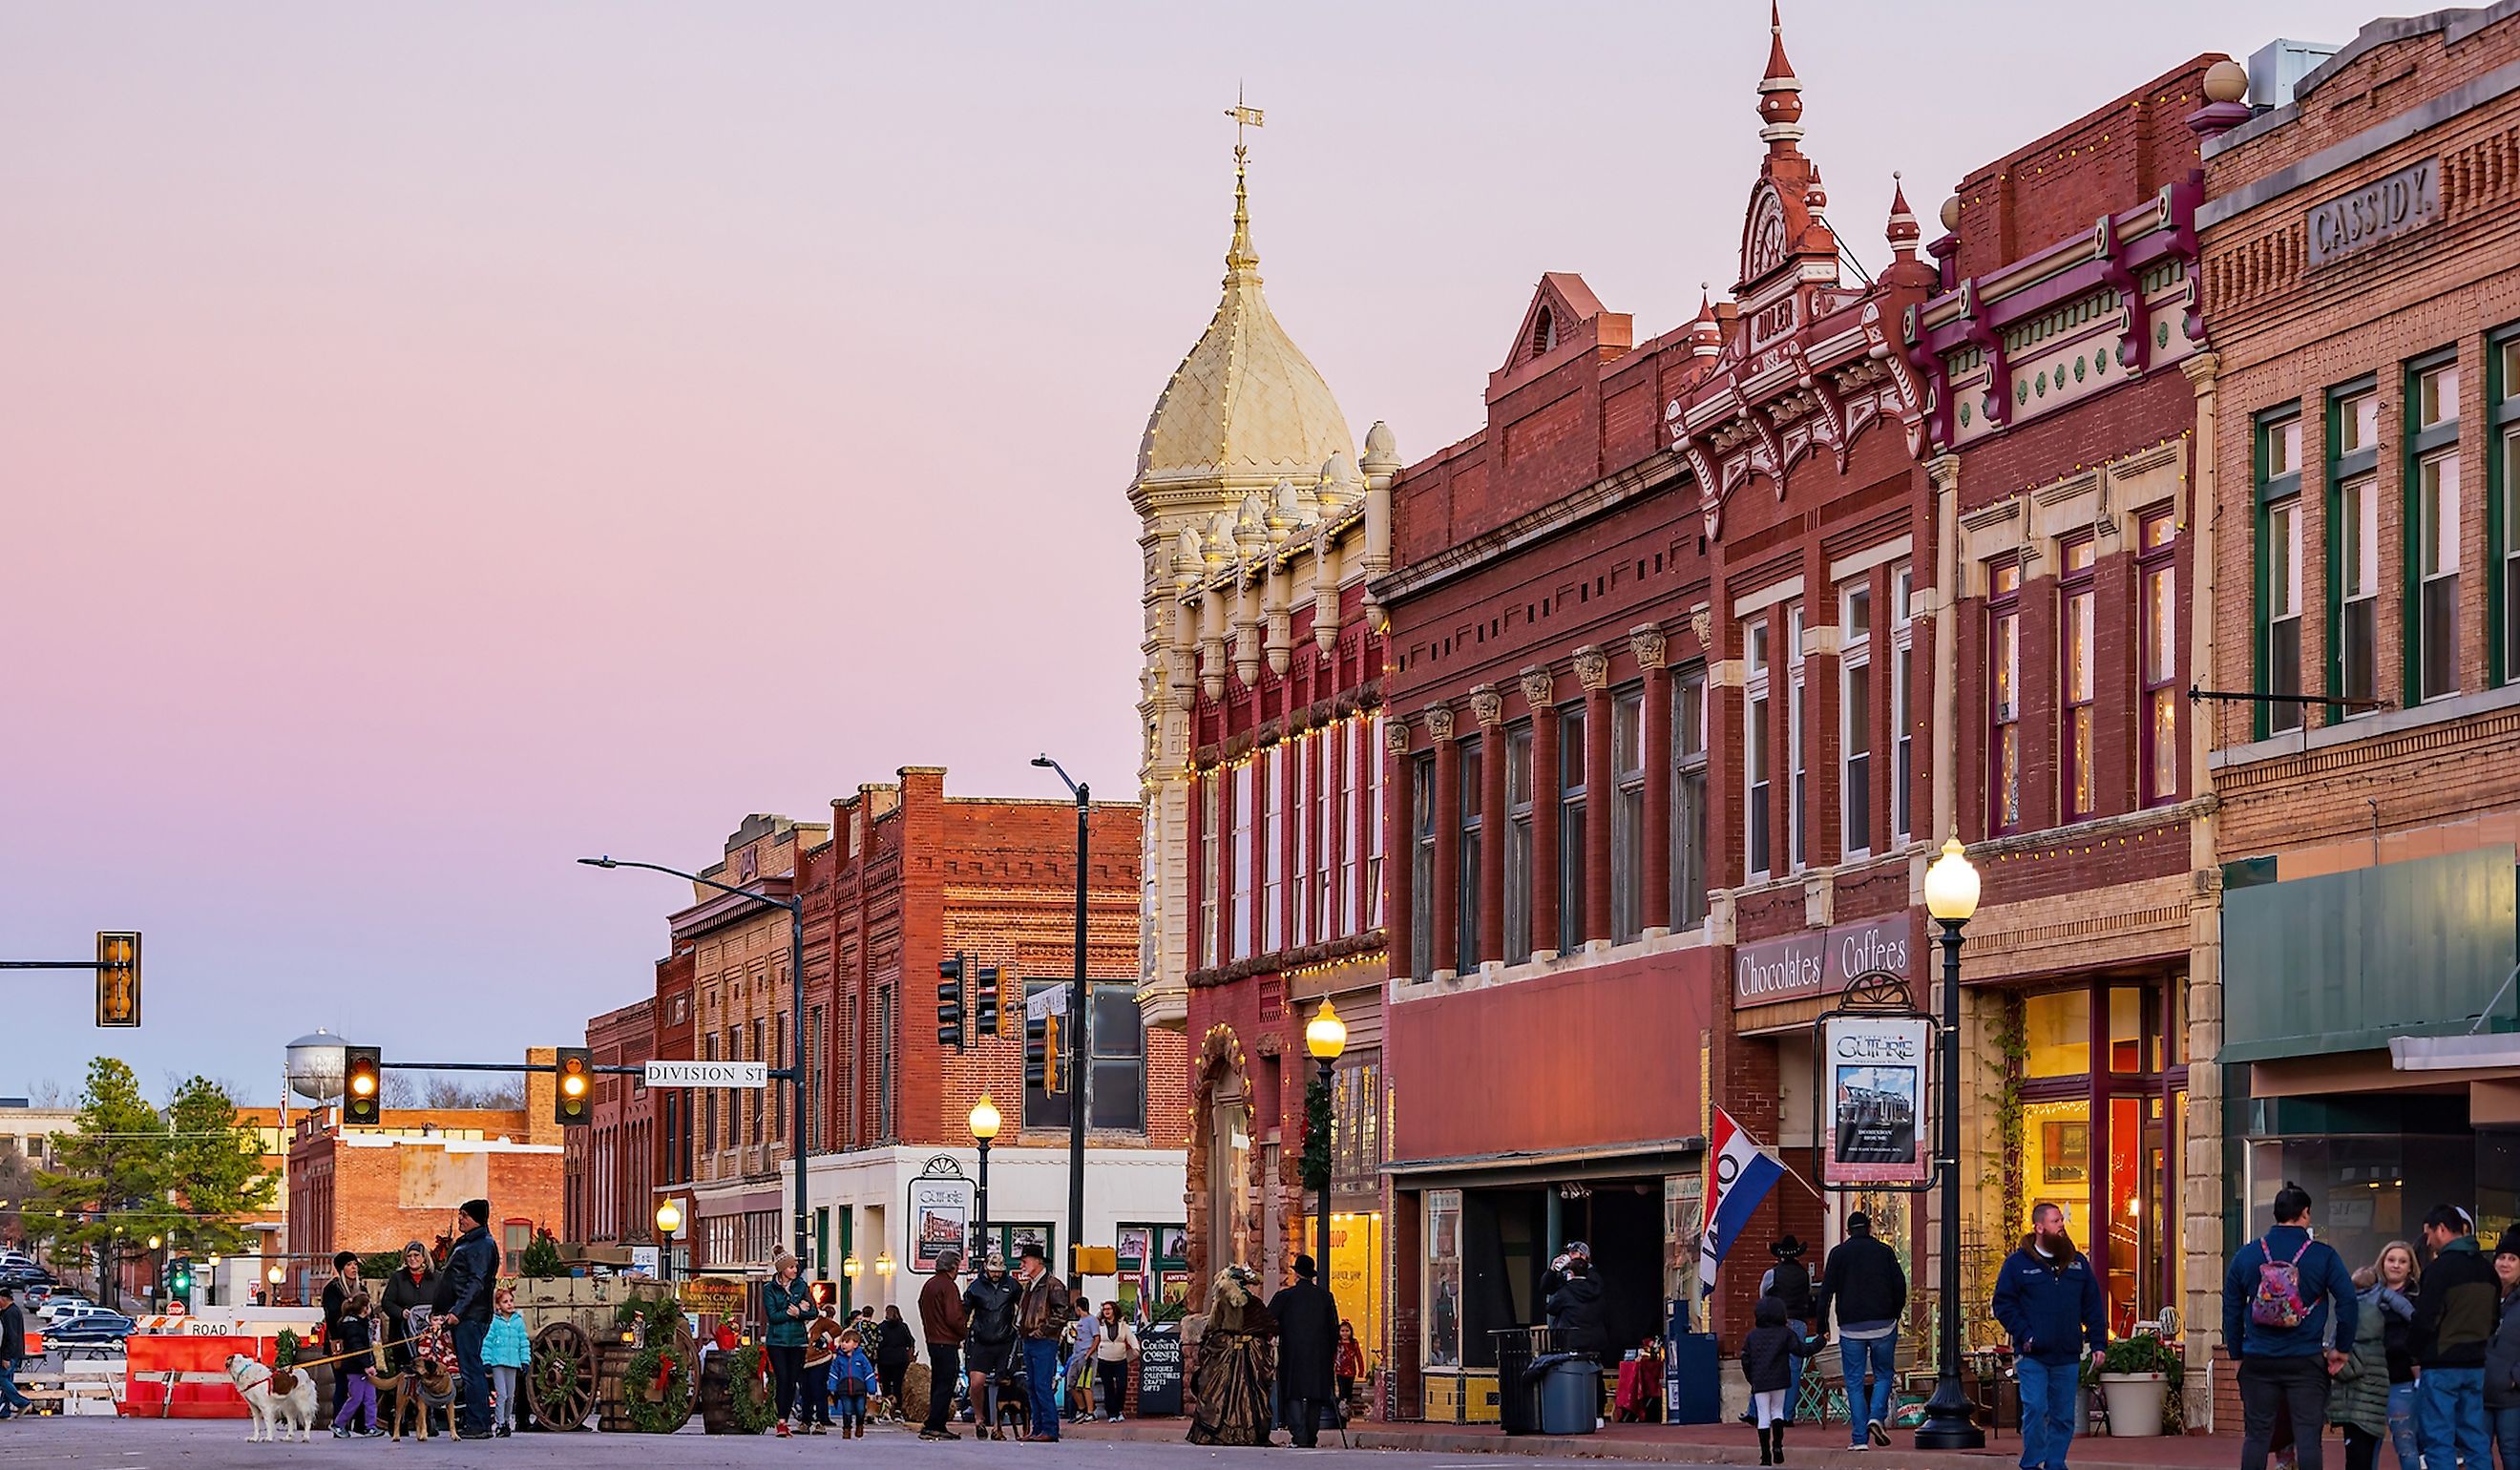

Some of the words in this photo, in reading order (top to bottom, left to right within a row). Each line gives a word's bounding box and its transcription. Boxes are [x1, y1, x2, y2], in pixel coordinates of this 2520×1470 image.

[1756, 298, 1794, 344] ADLER
[1738, 946, 1821, 997] Chocolates
[1841, 928, 1906, 979] Coffees
[1836, 1035, 1915, 1060] GUTHRIE
[648, 1066, 735, 1081] DIVISION
[745, 1066, 765, 1081] ST
[192, 1324, 228, 1336] ROAD
